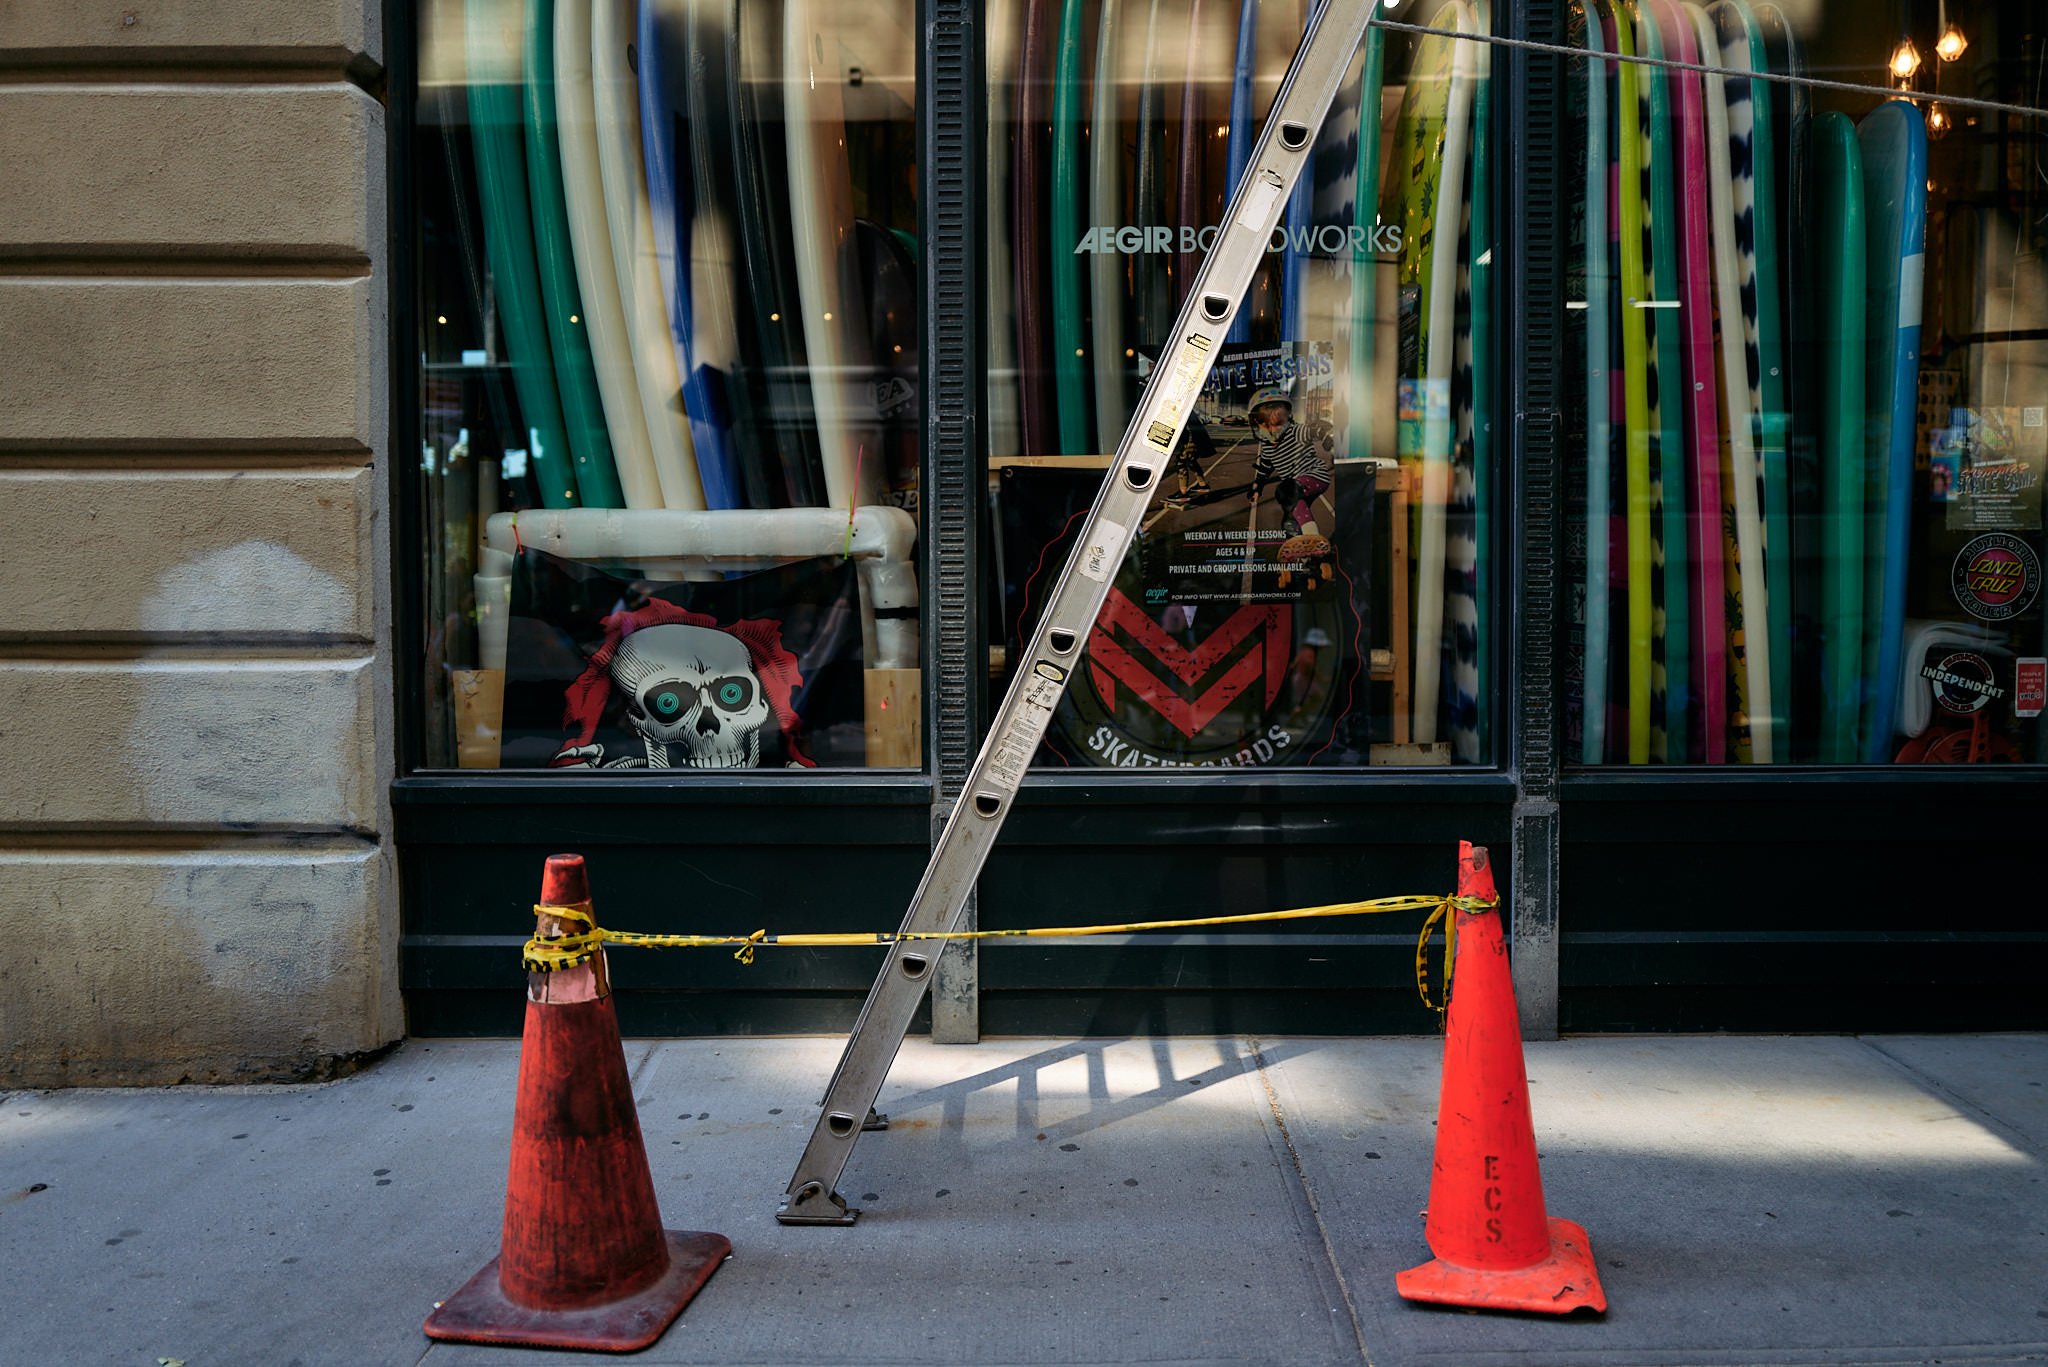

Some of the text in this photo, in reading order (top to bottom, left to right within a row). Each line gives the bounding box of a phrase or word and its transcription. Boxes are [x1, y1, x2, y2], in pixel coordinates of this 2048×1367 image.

[1179, 225, 1402, 253] BODWORKS
[1203, 363, 1246, 393] ATE
[1252, 354, 1331, 386] LESSONS
[1184, 530, 1287, 541] WEEKDAY & WEEKEND LESSONS
[1215, 547, 1256, 557] AGES 4 & UP
[1169, 562, 1303, 574] PRIVATE AND GROUP LESSONS AVAILABLE
[1967, 559, 2024, 577] SANTA
[1968, 576, 2016, 594] CRUZ
[1922, 665, 2005, 699] INDEPENDENT
[1088, 724, 1291, 767] SKATRDS
[1484, 1155, 1503, 1244] ECS
